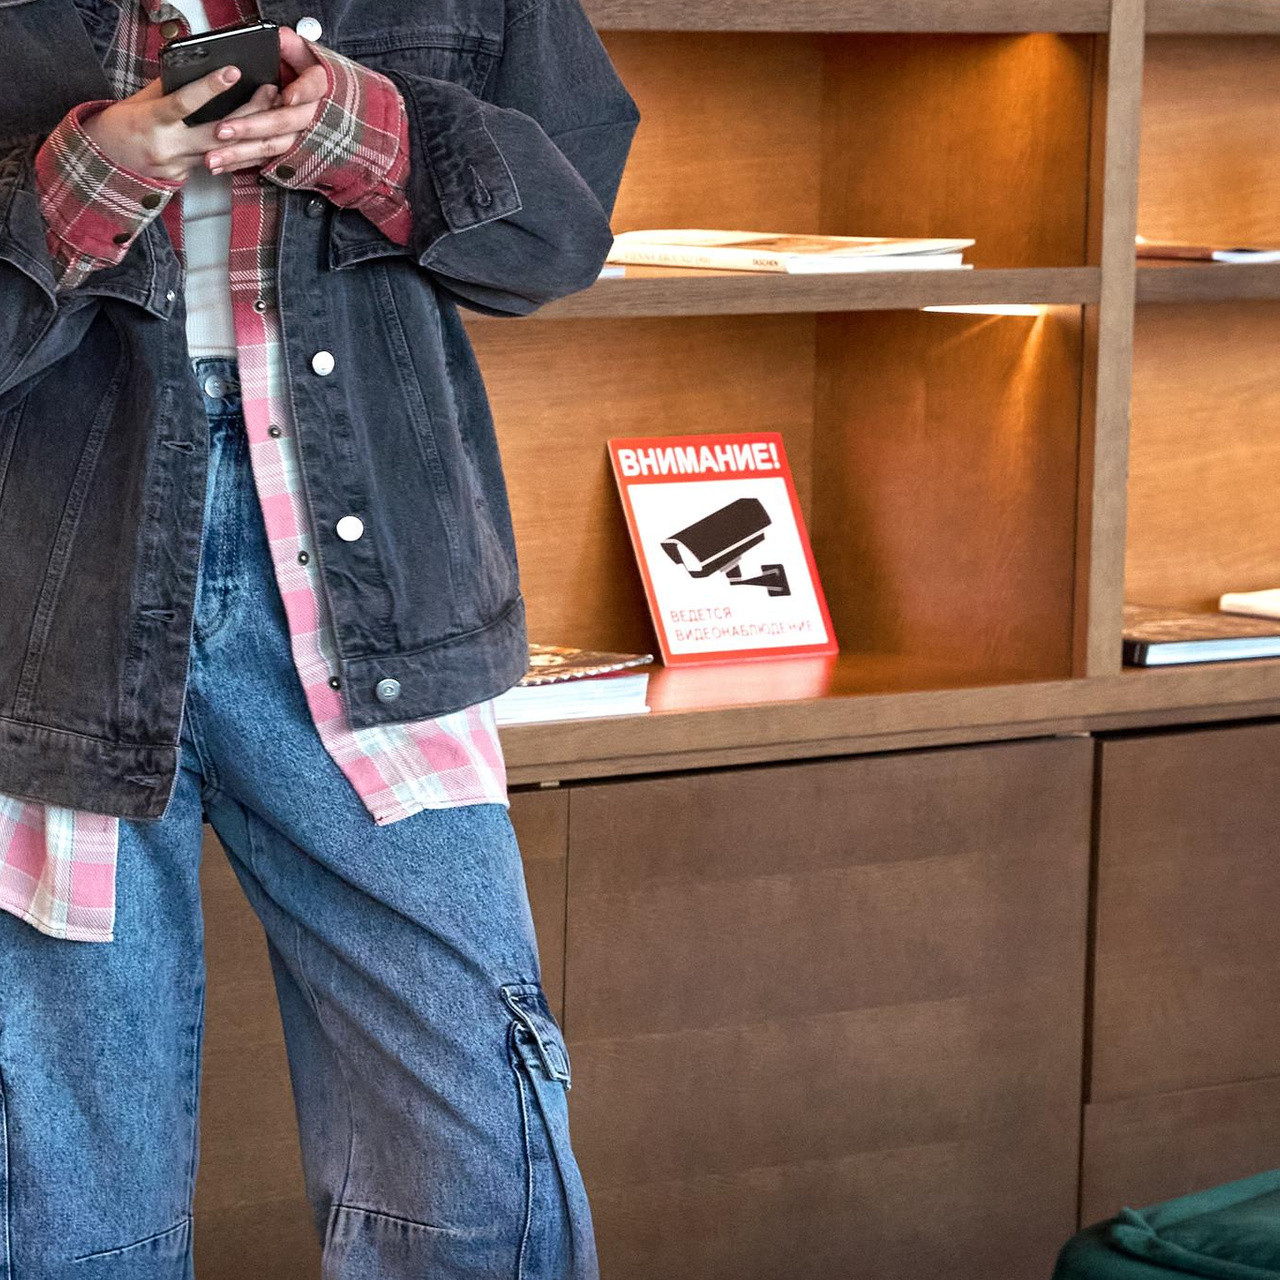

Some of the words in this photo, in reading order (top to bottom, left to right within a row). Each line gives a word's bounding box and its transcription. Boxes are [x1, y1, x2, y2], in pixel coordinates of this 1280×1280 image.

[753, 258, 779, 267] TASCHEN
[617, 443, 781, 477] ВНИМАНИЕ!
[670, 607, 733, 623] ВЕДЕТСЯ
